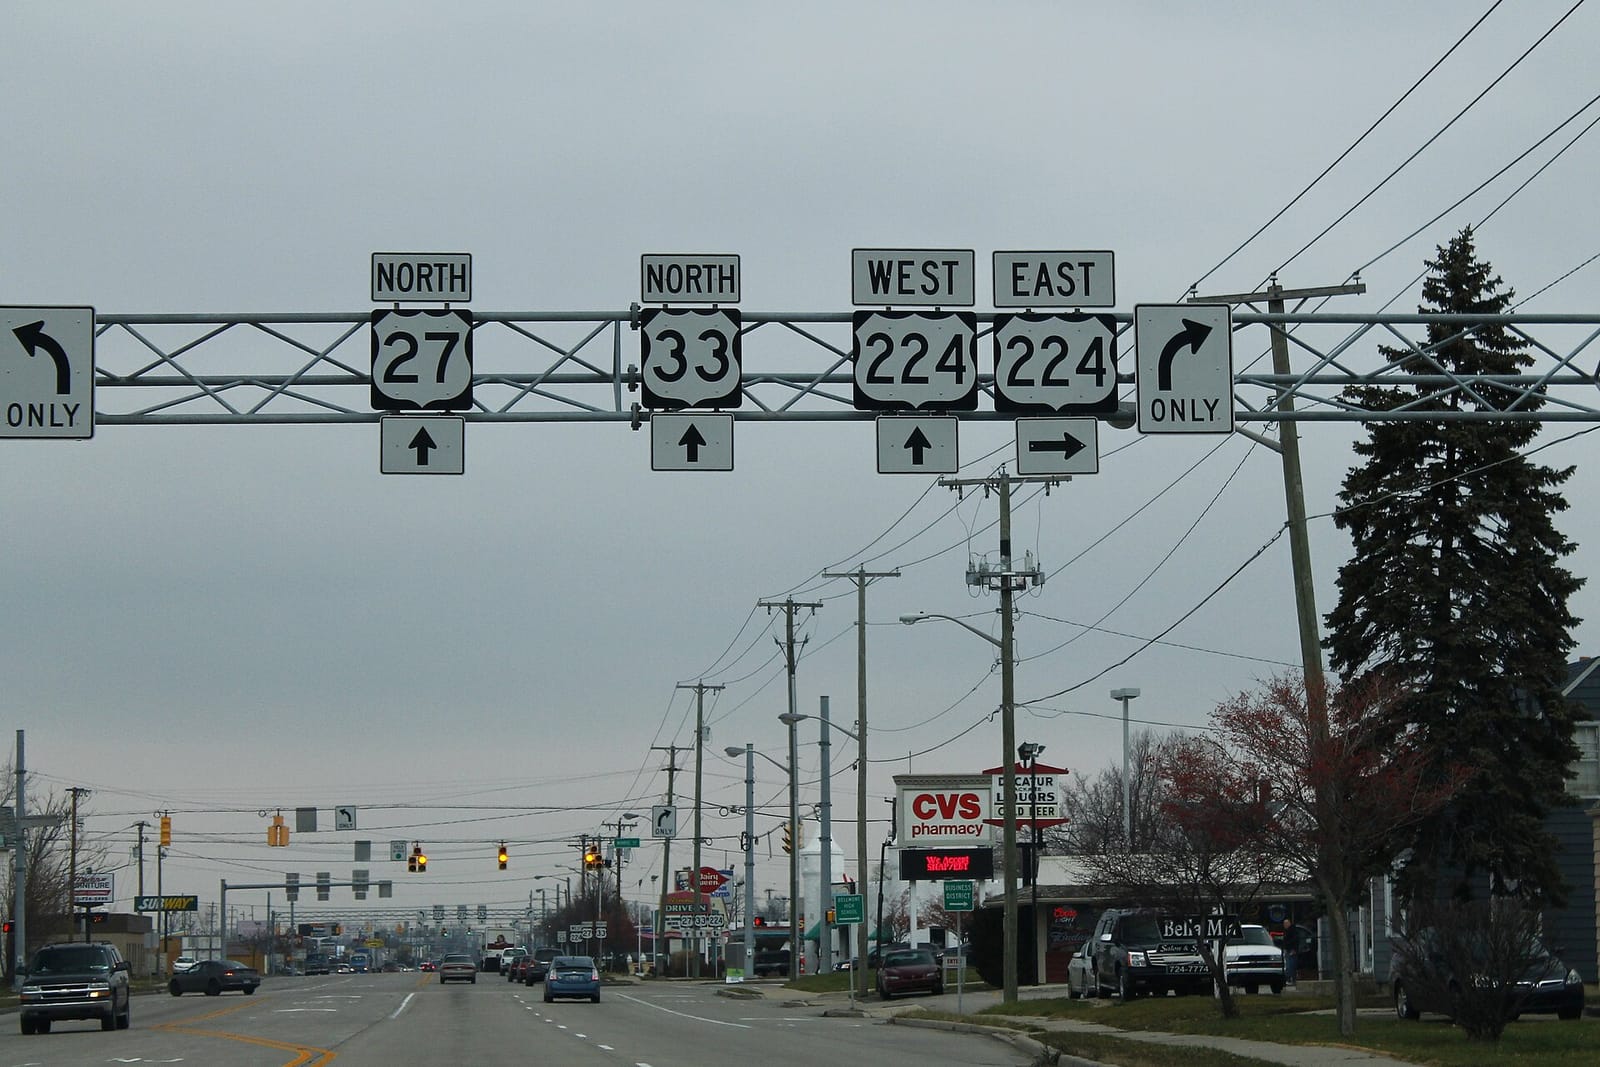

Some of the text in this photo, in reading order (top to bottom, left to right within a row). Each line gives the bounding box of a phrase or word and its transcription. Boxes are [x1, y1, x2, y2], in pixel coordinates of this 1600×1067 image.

[376, 262, 466, 293] NORTH
[647, 263, 735, 294] NORTH
[868, 260, 959, 296] WEST
[1011, 262, 1096, 297] EAST
[382, 331, 460, 384] 27
[652, 328, 730, 383] 33
[865, 332, 967, 385] 224
[1006, 334, 1107, 388] 224
[7, 402, 80, 428] ONLY
[1151, 397, 1220, 423] ONLY
[998, 777, 1053, 786] DCAUR
[996, 792, 1055, 802] LUORS
[912, 793, 981, 820] CVS
[998, 806, 1024, 816] CD
[655, 828, 673, 836] ONLY
[911, 822, 984, 838] pharmacy
[926, 856, 941, 864] We
[138, 897, 193, 911] SUBWAY
[665, 904, 693, 912] DRIVE
[681, 916, 693, 926] 27
[695, 916, 706, 926] 33
[709, 916, 723, 926] 224
[582, 929, 592, 937] 27
[1169, 965, 1209, 973] 724-7774
